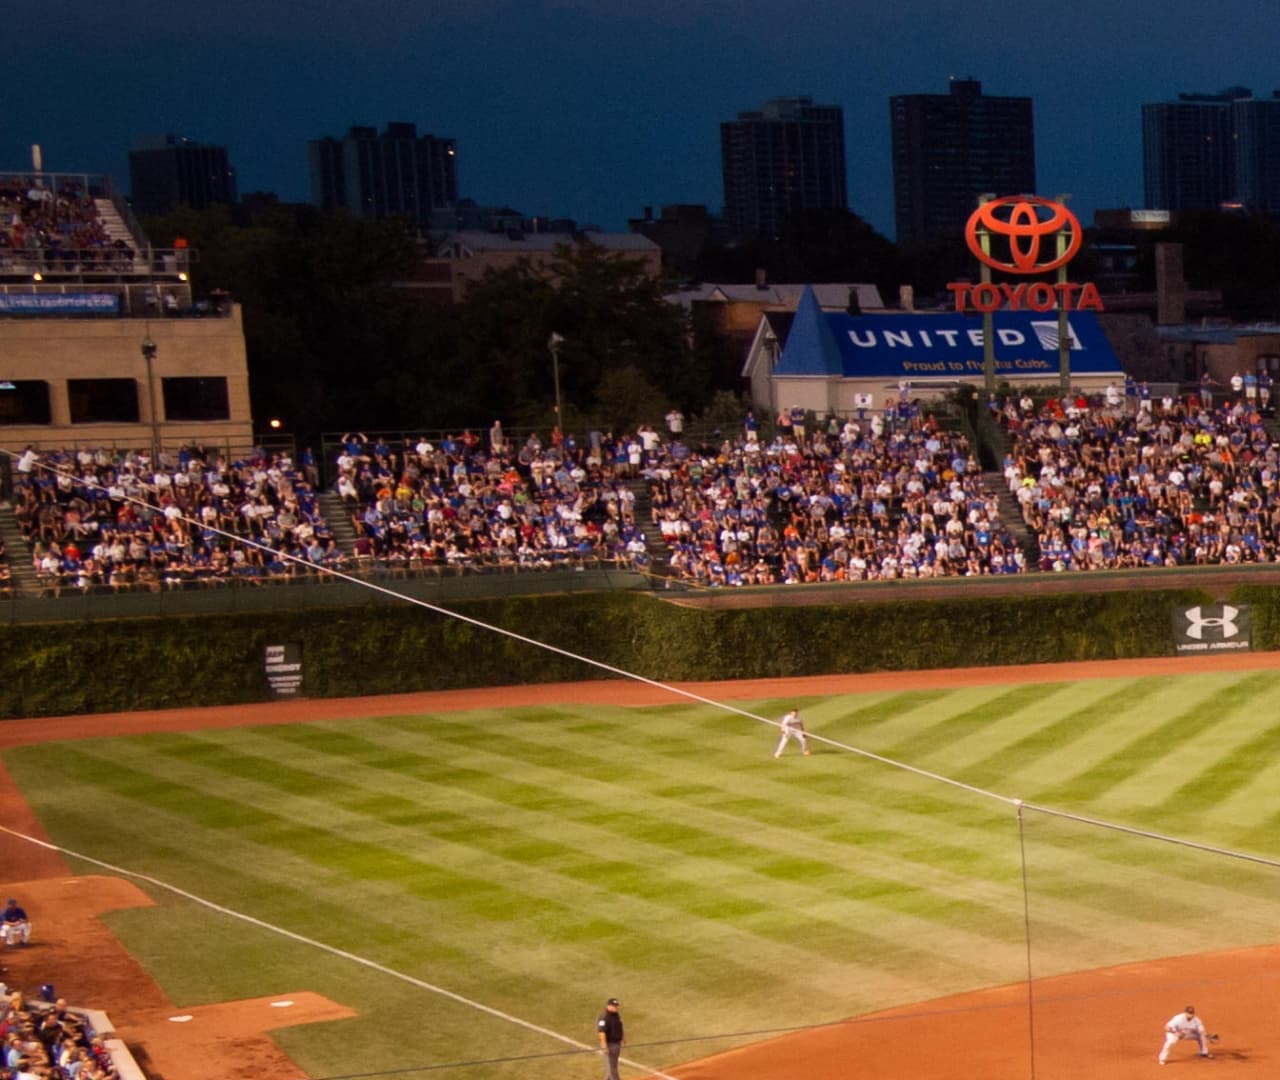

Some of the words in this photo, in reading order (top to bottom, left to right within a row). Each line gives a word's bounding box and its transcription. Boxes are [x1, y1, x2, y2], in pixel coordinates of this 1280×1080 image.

[947, 282, 1105, 312] TOYOTA
[847, 329, 1025, 348] UNITED
[903, 361, 945, 371] Proud
[949, 361, 963, 371] to
